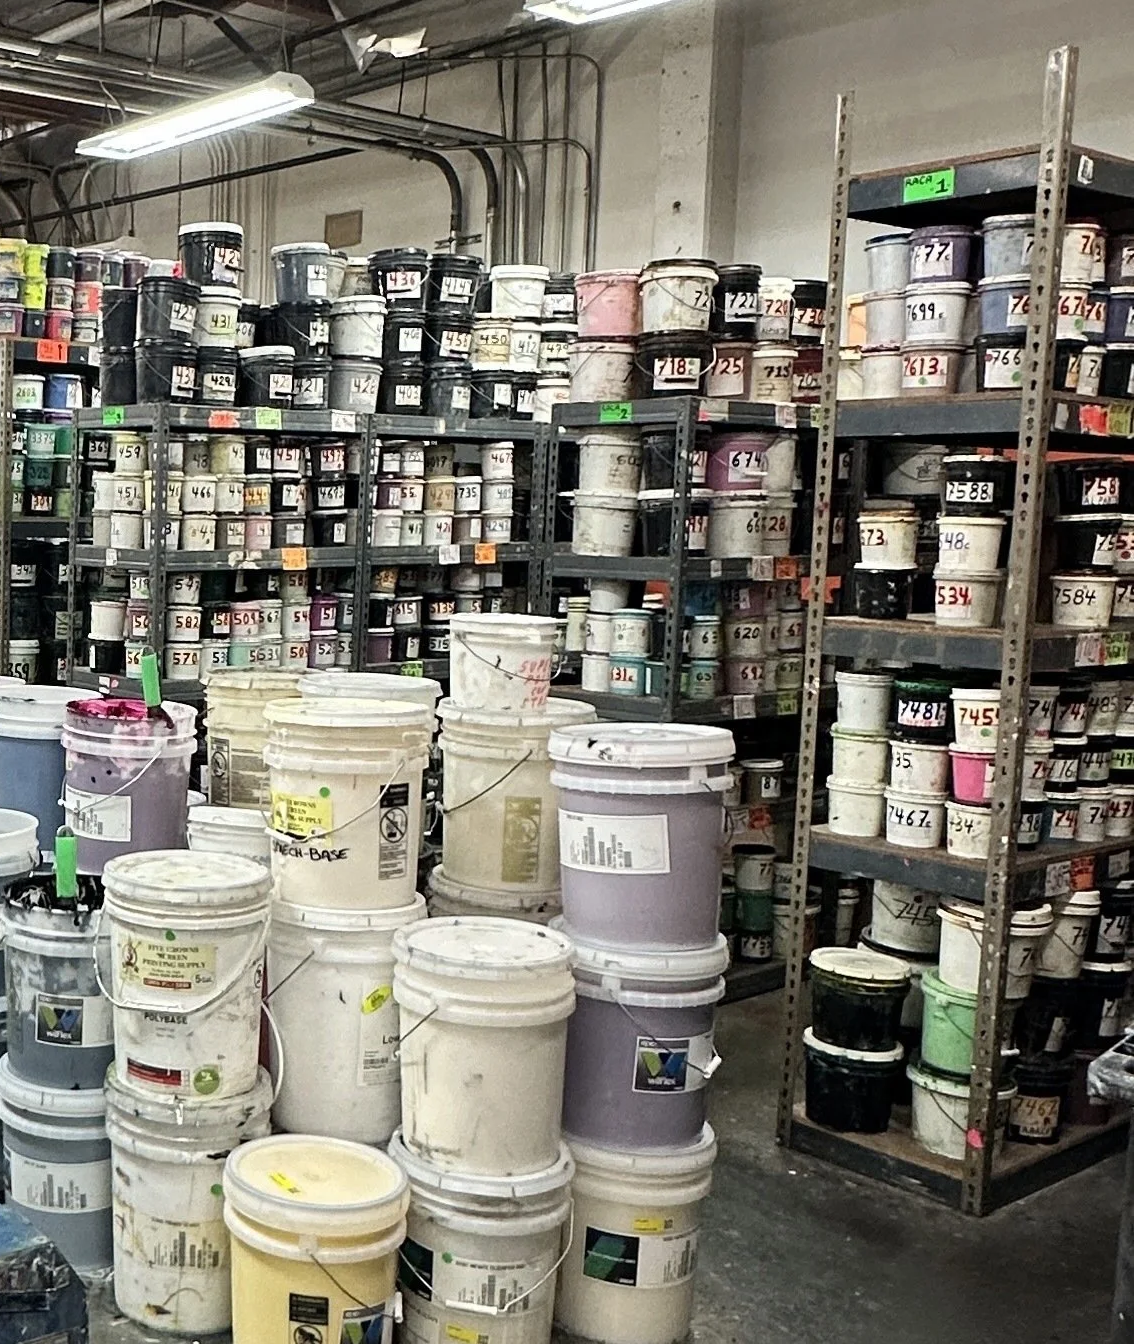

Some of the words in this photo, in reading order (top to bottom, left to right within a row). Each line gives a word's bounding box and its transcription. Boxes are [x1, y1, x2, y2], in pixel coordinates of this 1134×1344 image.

[935, 178, 949, 194] 1
[389, 273, 416, 286] 436
[731, 451, 762, 468] 674
[175, 616, 199, 629] 582
[733, 627, 760, 639] 620
